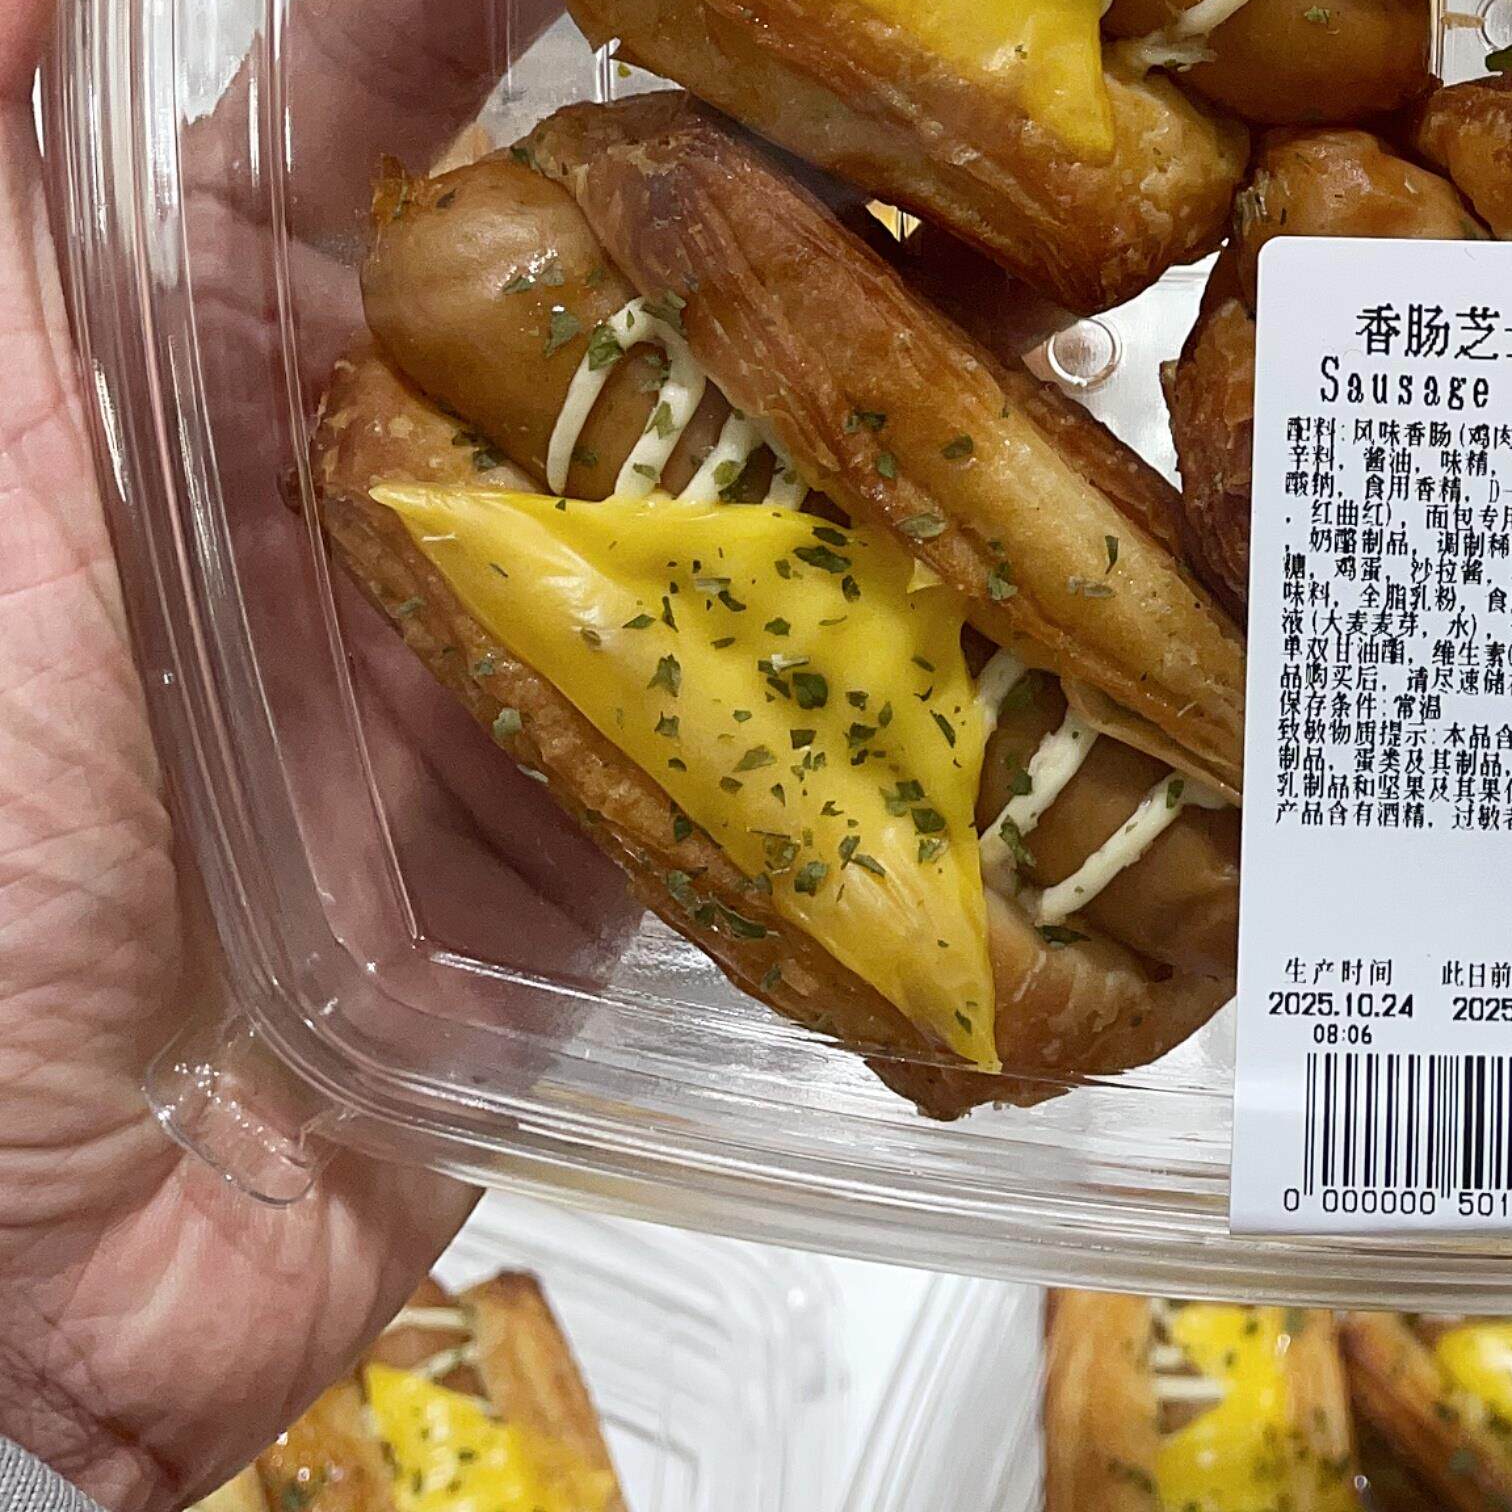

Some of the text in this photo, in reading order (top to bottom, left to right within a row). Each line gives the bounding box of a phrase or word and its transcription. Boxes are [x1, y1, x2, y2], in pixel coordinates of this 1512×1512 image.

[1319, 356, 1490, 409] Sausage
[1284, 958, 1393, 985] 生产时间
[1268, 991, 1414, 1019] 2025.10.24
[1313, 1024, 1373, 1044] 08:06
[1283, 1188, 1300, 1212] 0
[1322, 1189, 1436, 1216] 000000
